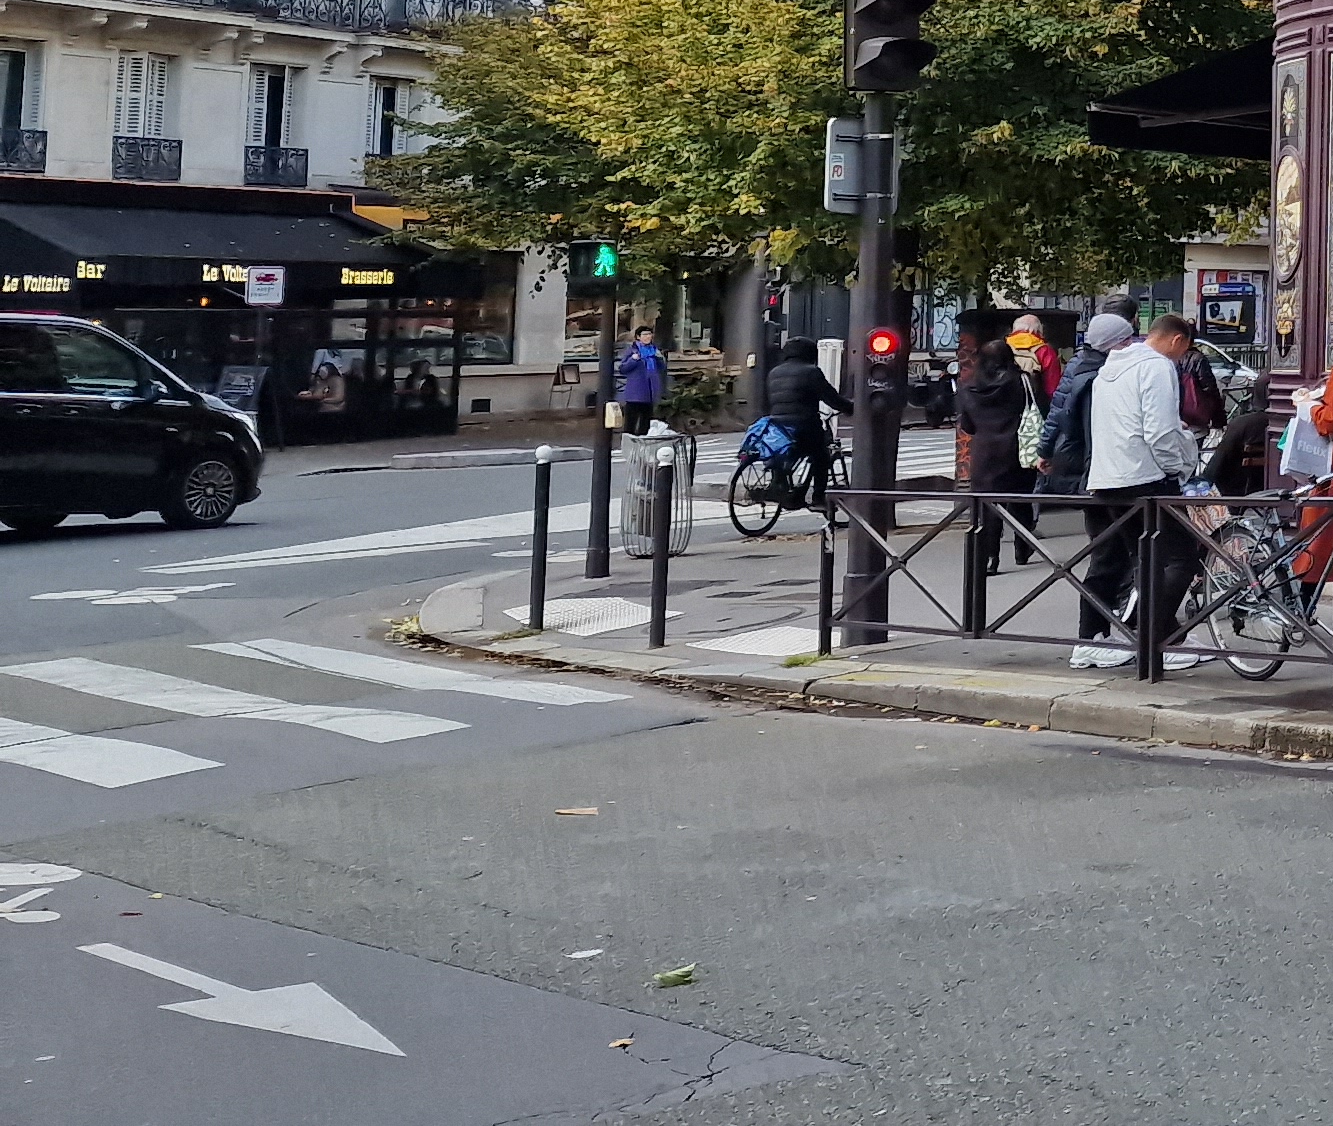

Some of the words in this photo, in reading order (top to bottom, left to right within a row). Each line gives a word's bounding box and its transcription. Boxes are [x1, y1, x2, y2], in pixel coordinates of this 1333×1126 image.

[76, 260, 106, 278] Bar
[202, 264, 219, 282] Le
[221, 264, 248, 282] Volta
[341, 268, 394, 284] Brasserie
[2, 274, 19, 292] Le
[23, 274, 71, 292] Voltaire
